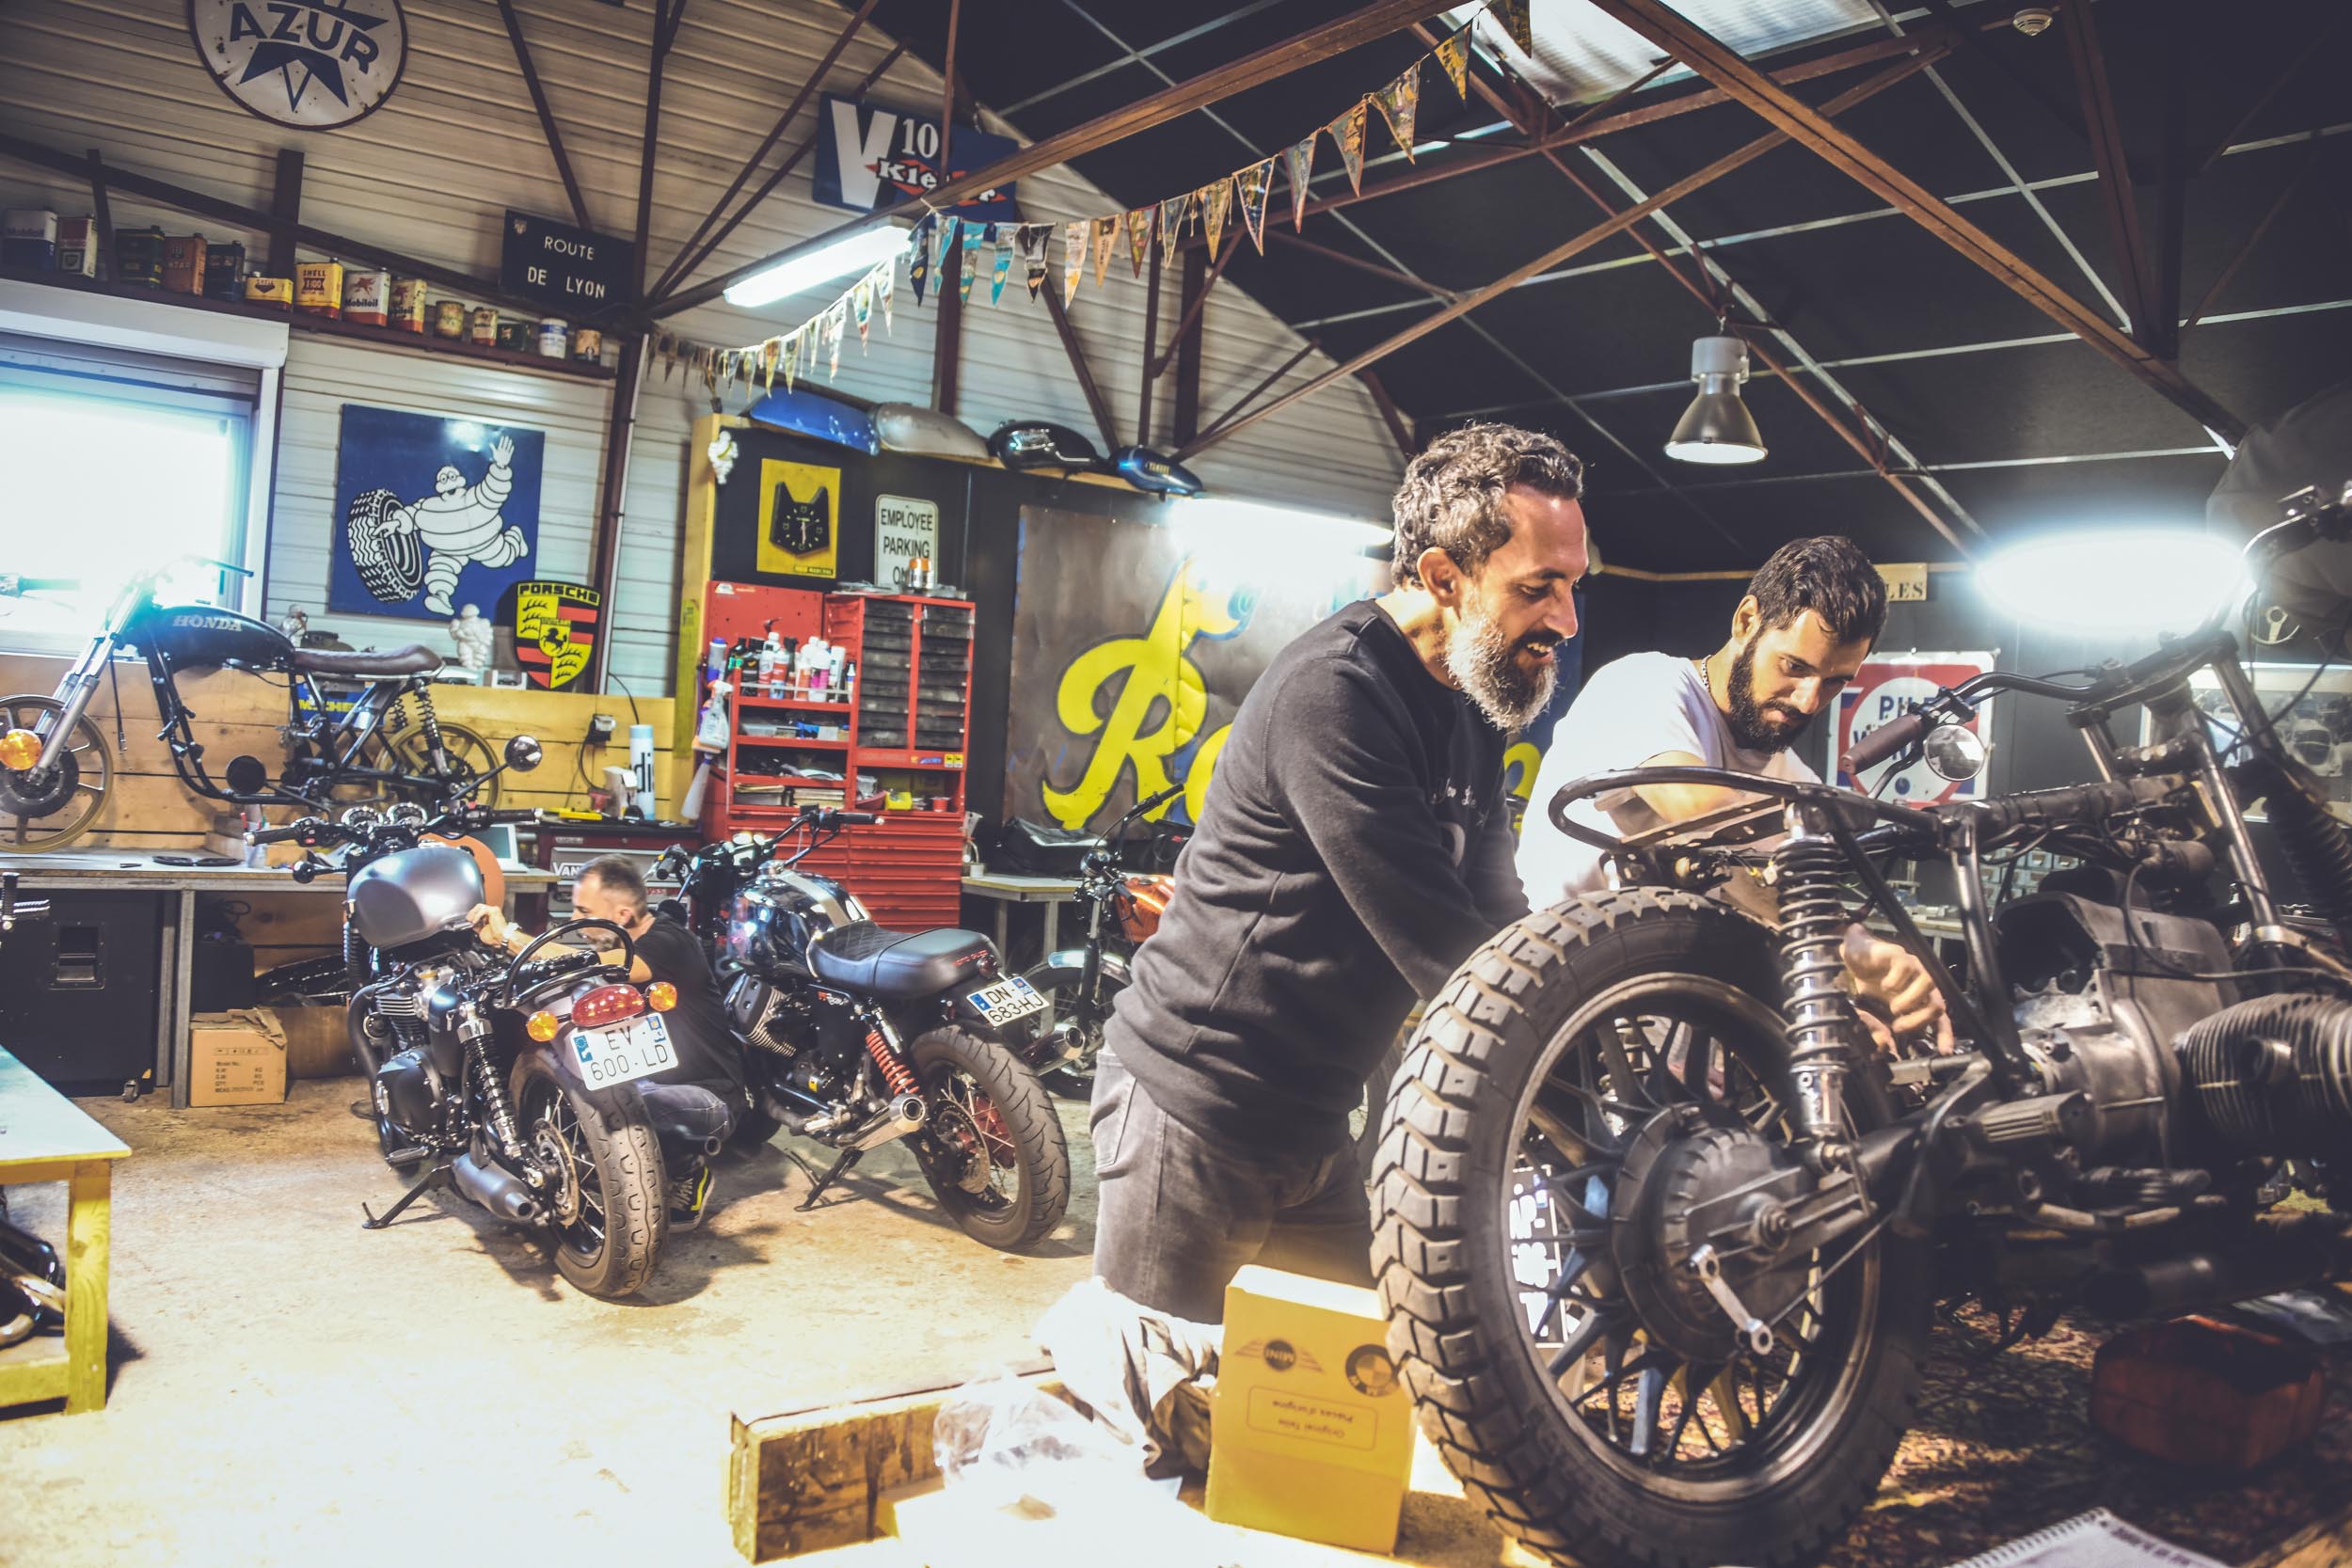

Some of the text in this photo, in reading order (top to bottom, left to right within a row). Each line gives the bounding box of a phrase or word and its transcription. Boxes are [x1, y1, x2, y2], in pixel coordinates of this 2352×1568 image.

[230, 2, 379, 74] AZUR
[833, 99, 939, 210] V 10
[545, 235, 595, 261] ROUTE
[304, 269, 326, 277] SHELL
[527, 266, 605, 299] DE LYON
[344, 298, 378, 309] Mobiloil
[881, 509, 933, 531] EMPLOYEE
[882, 536, 930, 559] PARKING
[519, 584, 599, 603] PORSCHE
[172, 614, 243, 631] HONDA
[985, 987, 1012, 1005] DN
[1265, 1349, 1295, 1363] MINI
